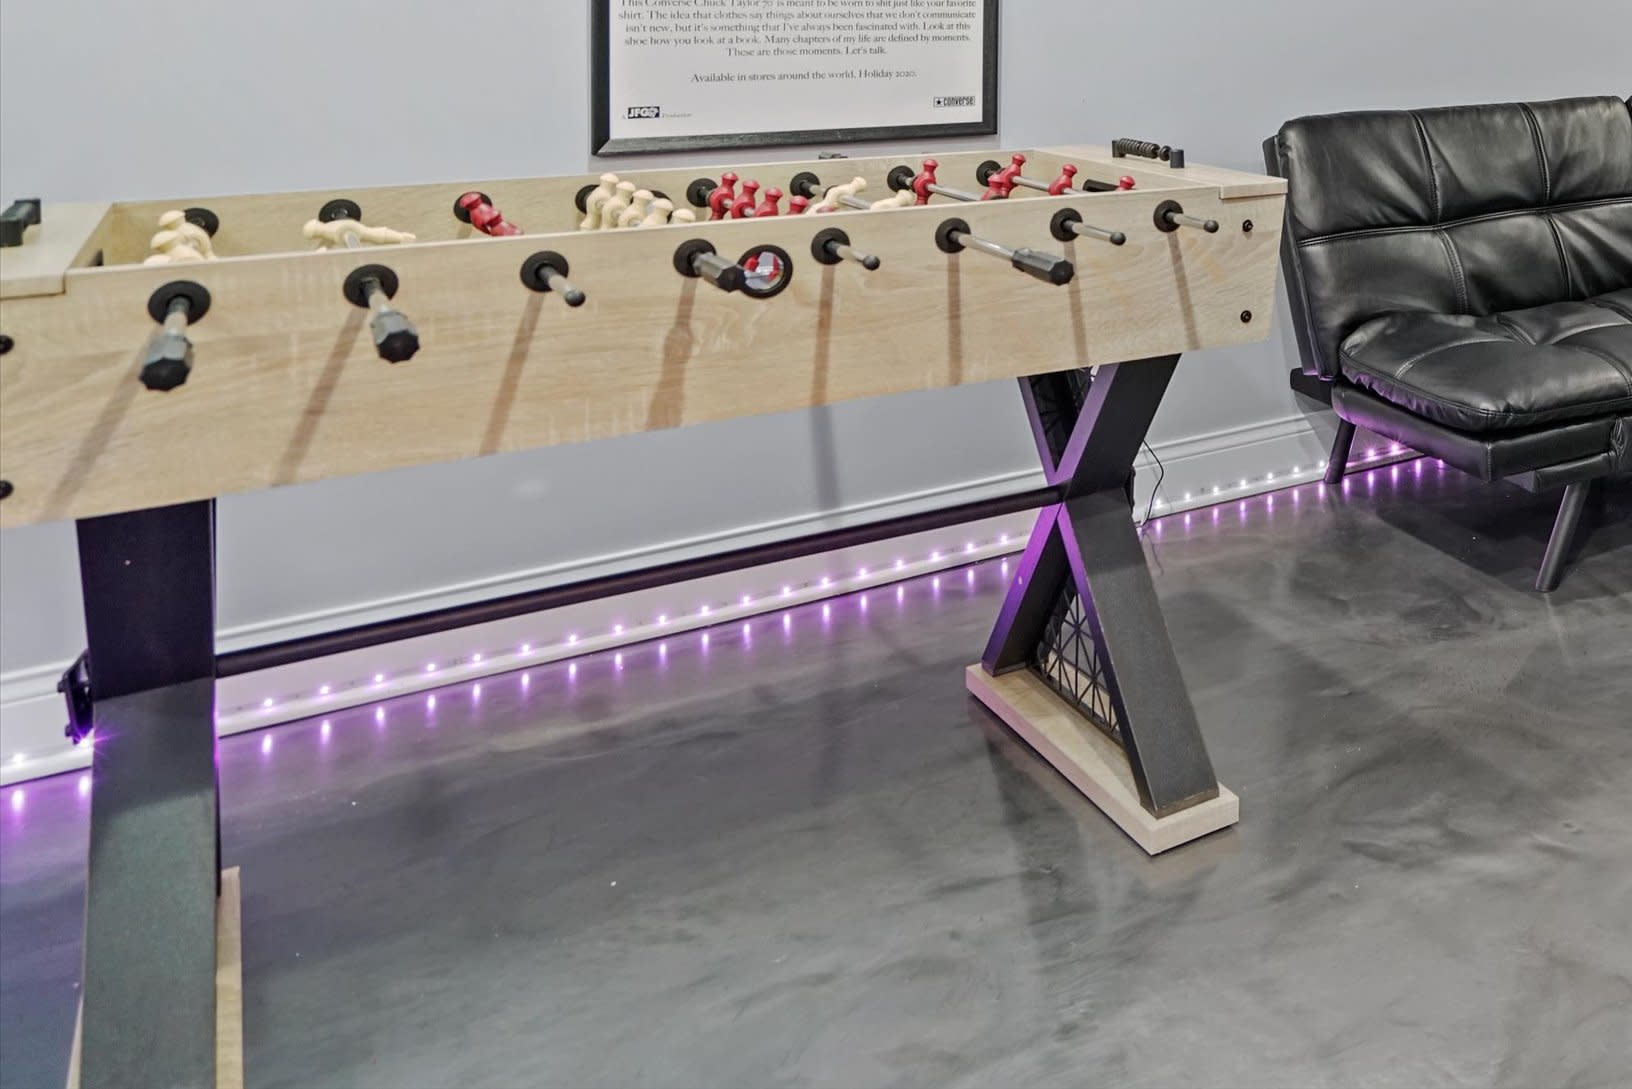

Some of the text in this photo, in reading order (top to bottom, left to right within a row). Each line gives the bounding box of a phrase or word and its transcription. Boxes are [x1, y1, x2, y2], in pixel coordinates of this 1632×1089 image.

[786, 0, 814, 7] meant
[893, 0, 908, 9] just
[910, 0, 925, 7] like
[927, 0, 944, 9] your
[646, 10, 668, 19] The
[670, 10, 690, 19] idea
[693, 10, 711, 19] that
[714, 10, 747, 19] clothes
[749, 12, 762, 21] say
[766, 10, 794, 21] things
[797, 10, 822, 19] about
[824, 10, 864, 18] ourselves
[866, 10, 883, 18] that
[899, 10, 921, 18] don't
[922, 10, 976, 18] communicate
[675, 23, 691, 32] but
[710, 23, 760, 34] something
[762, 23, 780, 31] that
[801, 23, 831, 33] always
[832, 23, 854, 31] been
[855, 22, 898, 31] fascinated
[923, 21, 944, 30] Look
[956, 22, 971, 30] this
[624, 36, 648, 45] shoe
[650, 36, 670, 45] how
[673, 38, 691, 47] you
[693, 36, 713, 44] look
[764, 35, 790, 45] Many
[792, 34, 831, 45] chapters
[858, 34, 871, 42] life
[888, 34, 918, 42] defined
[726, 47, 755, 56] These
[773, 47, 797, 55] those
[690, 73, 734, 82] Available
[748, 72, 776, 81] stores
[777, 71, 810, 80] around
[812, 71, 826, 80] the
[858, 69, 892, 80] Holiday
